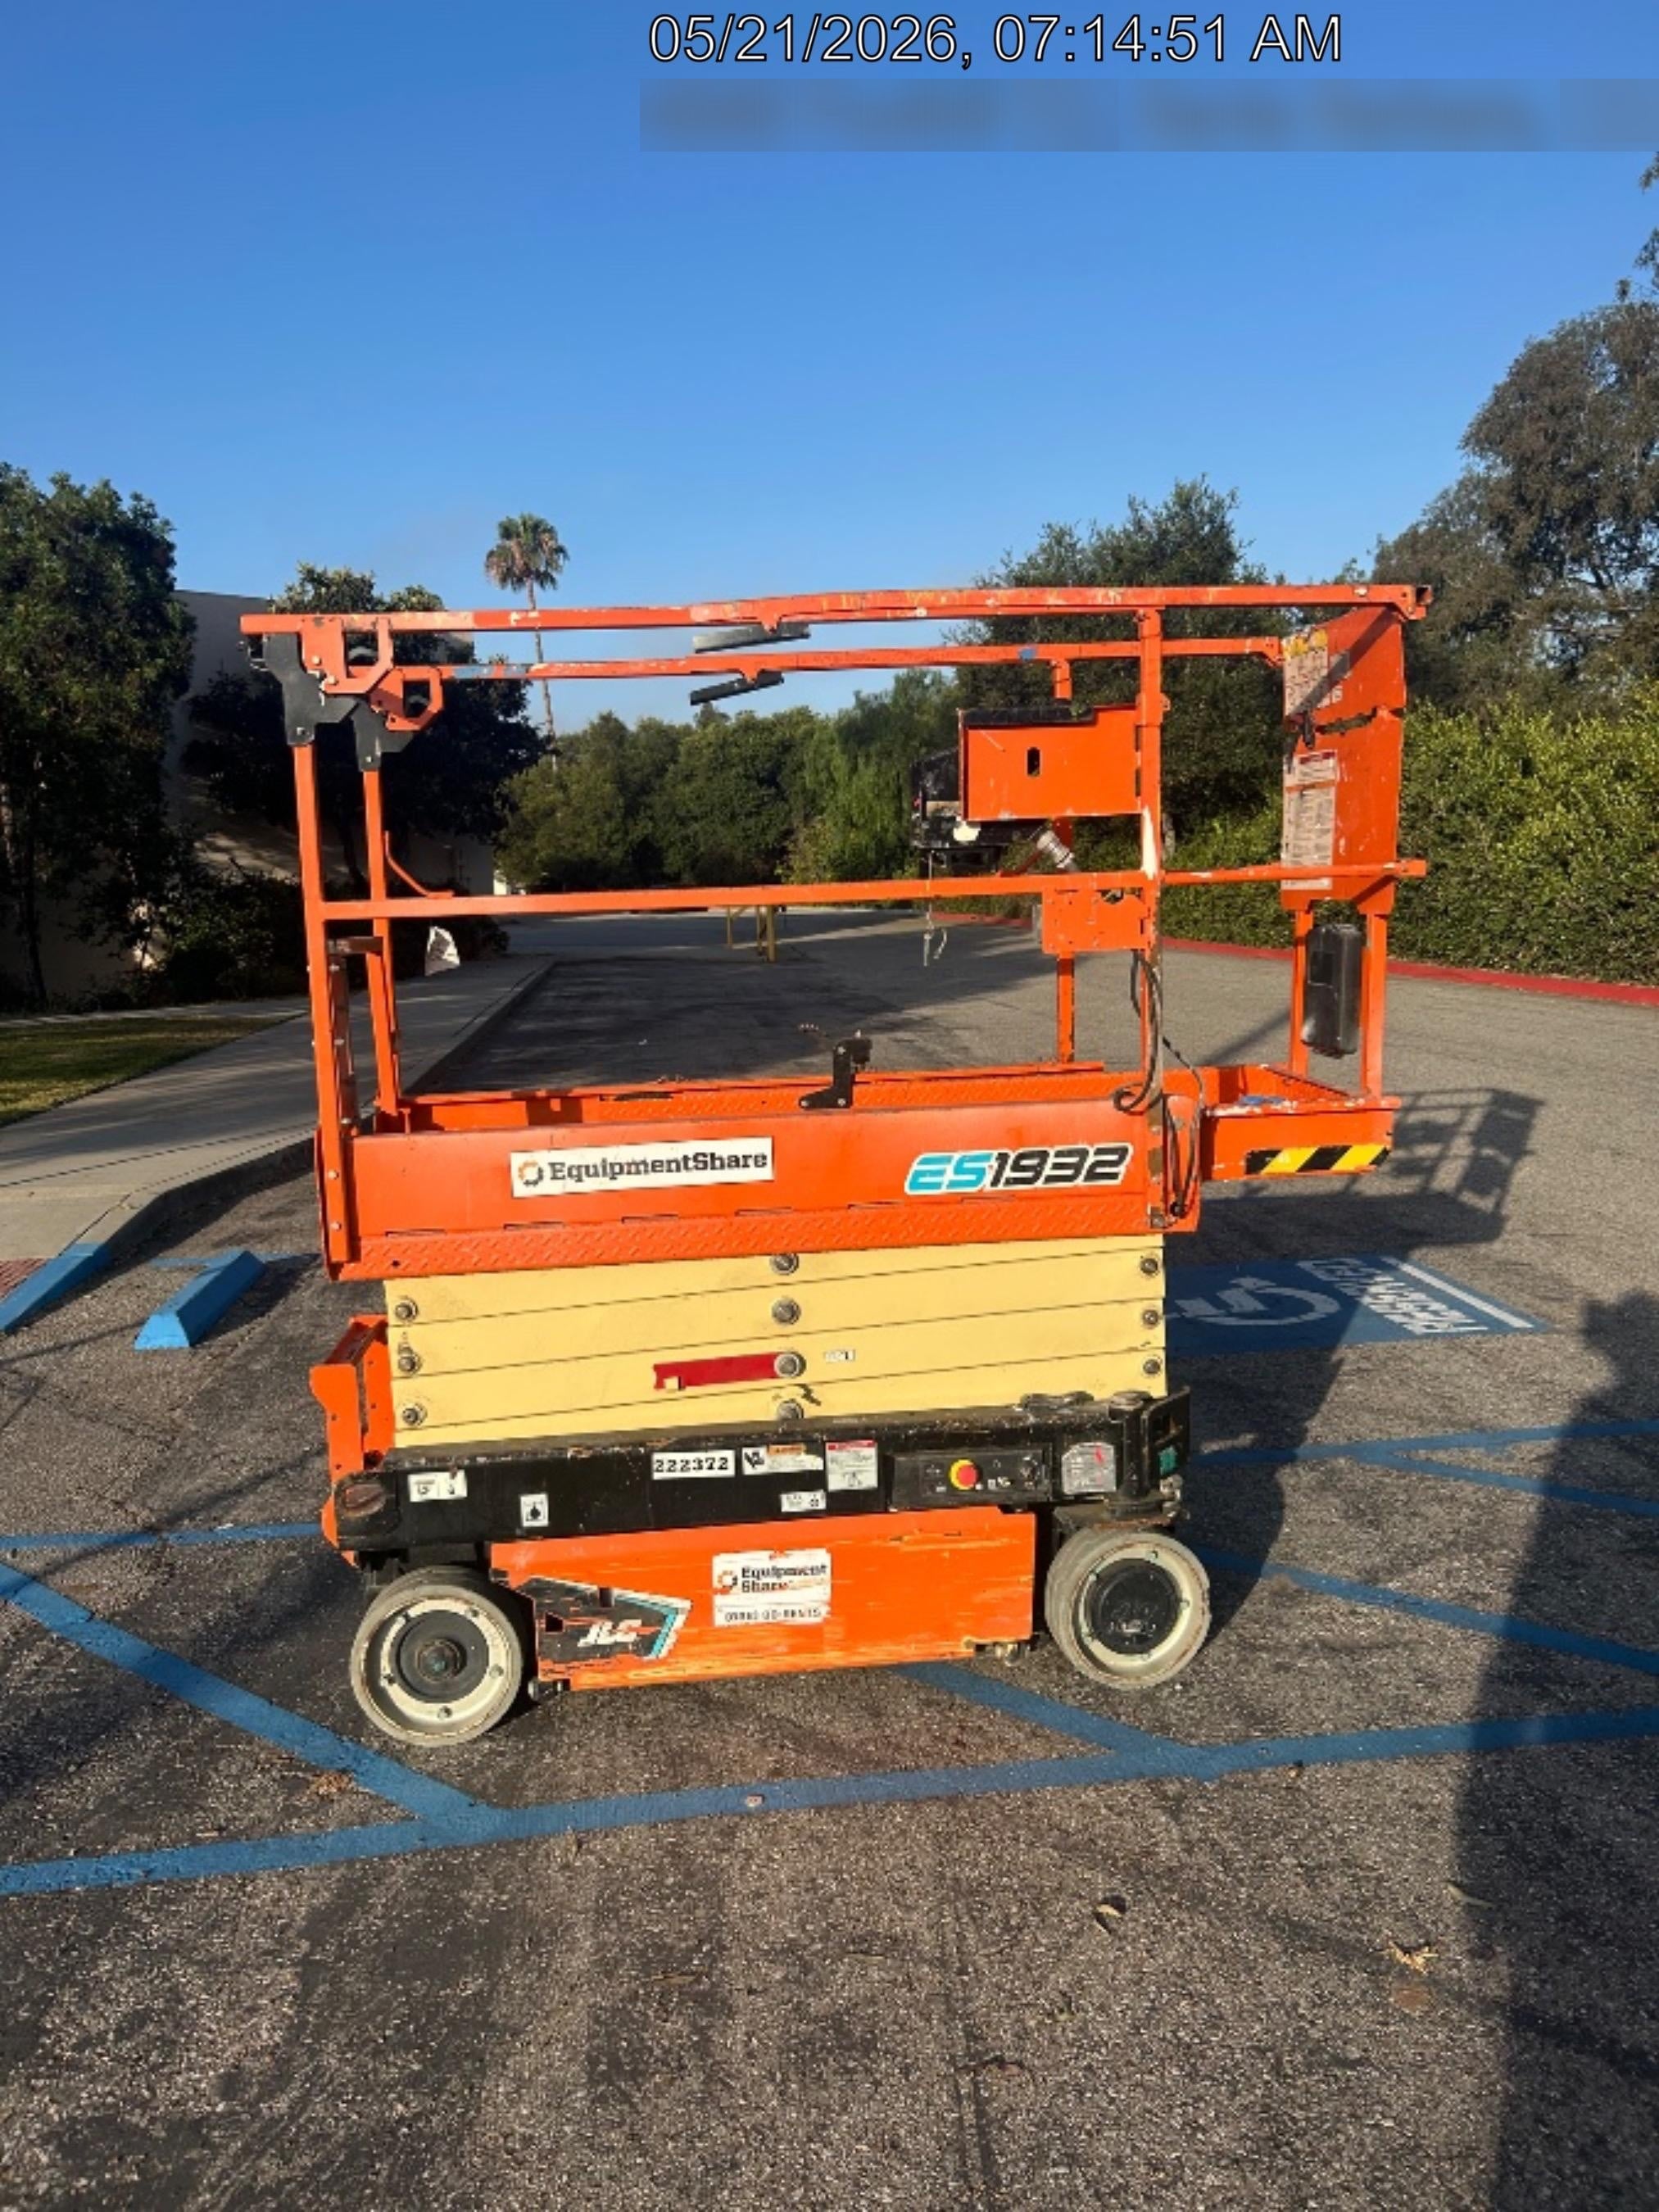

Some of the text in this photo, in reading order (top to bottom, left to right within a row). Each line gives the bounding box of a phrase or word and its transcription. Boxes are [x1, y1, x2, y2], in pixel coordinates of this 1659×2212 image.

[548, 1151, 768, 1183] EquipmentShare
[906, 1145, 1131, 1192] ES1932
[655, 1456, 728, 1473] 222372
